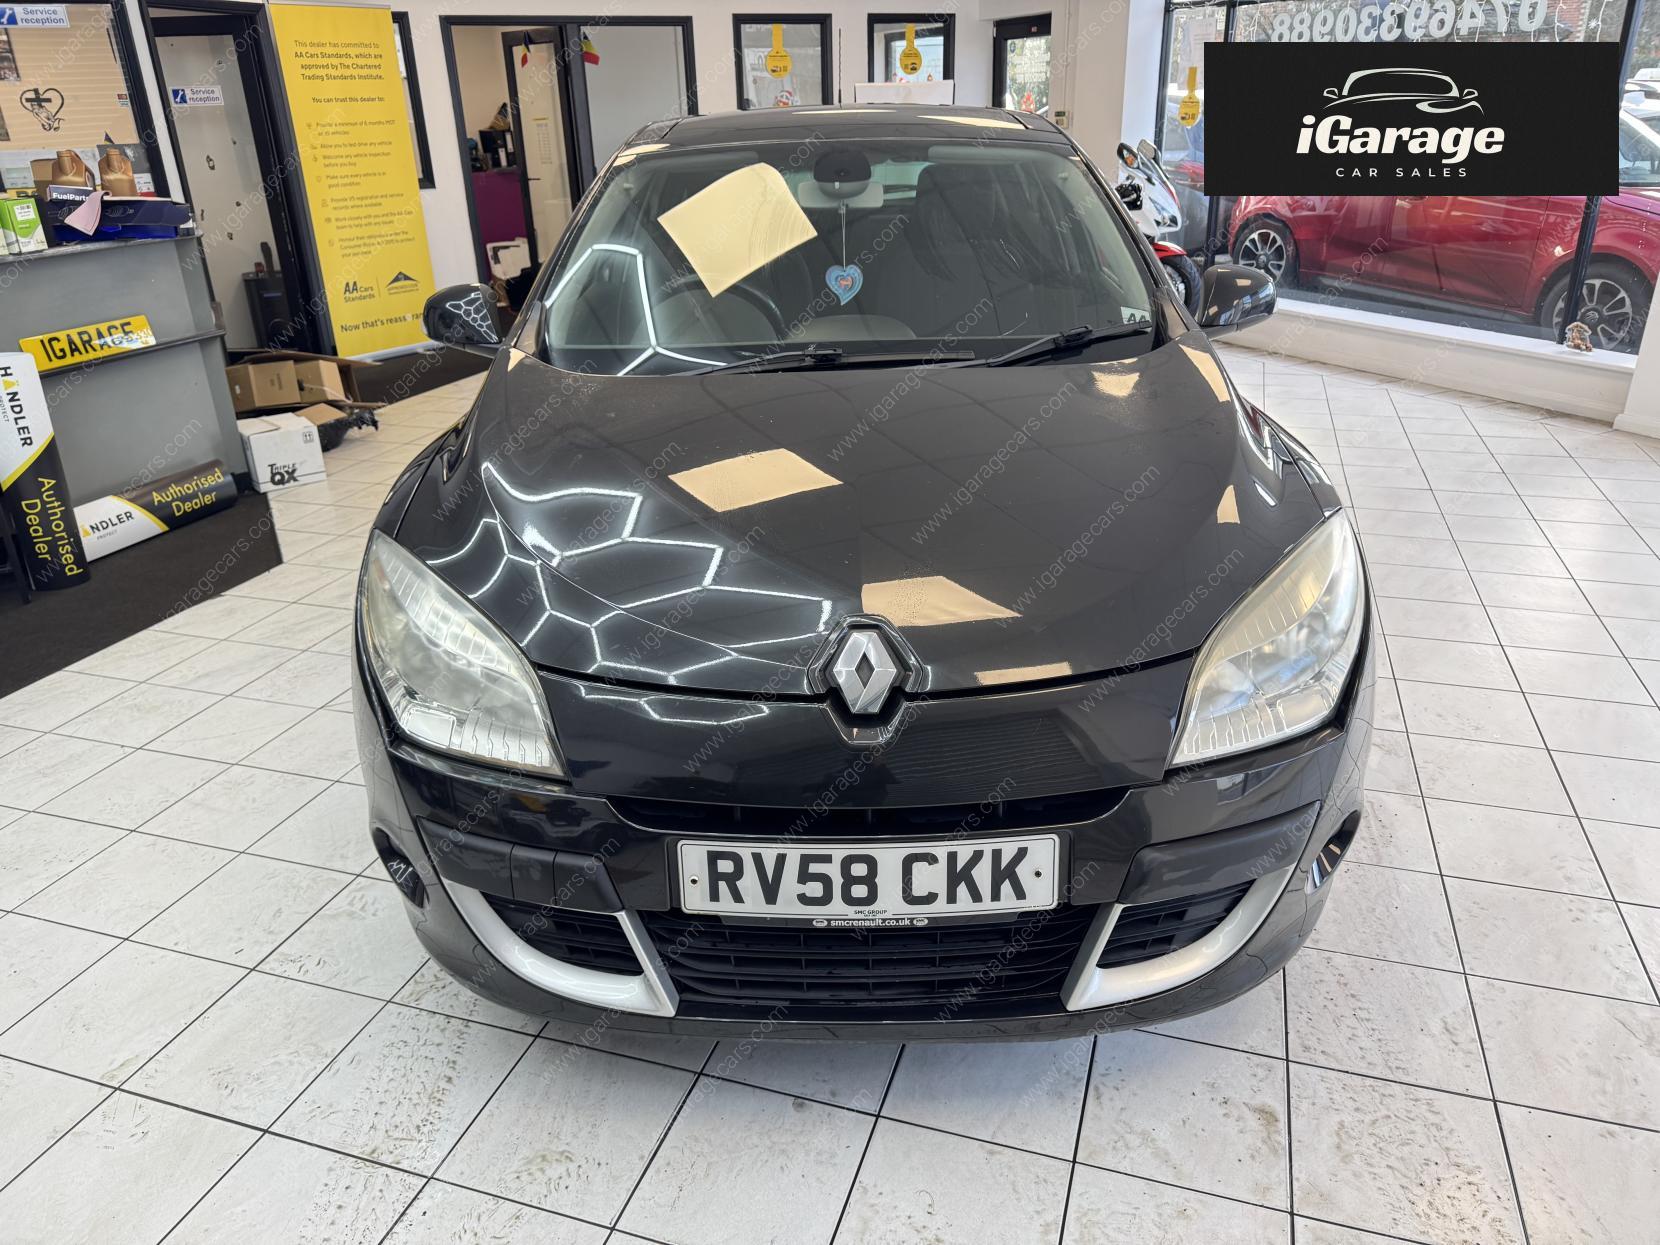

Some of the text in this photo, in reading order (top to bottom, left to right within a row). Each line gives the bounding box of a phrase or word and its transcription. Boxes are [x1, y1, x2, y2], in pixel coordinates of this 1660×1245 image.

[21, 17, 65, 25] reception
[23, 8, 57, 16] Service
[294, 40, 307, 48] This
[344, 281, 358, 295] AA
[344, 293, 375, 302] Standards
[341, 312, 424, 332] Now that's reassran
[270, 468, 299, 486] QX
[151, 468, 225, 506] Authorised
[172, 490, 217, 518] Dealer
[21, 499, 52, 560] Dealer
[38, 477, 84, 576] Authorised
[706, 846, 1029, 907] RV58 CKK
[830, 918, 910, 927] smcrenault.co.uk
